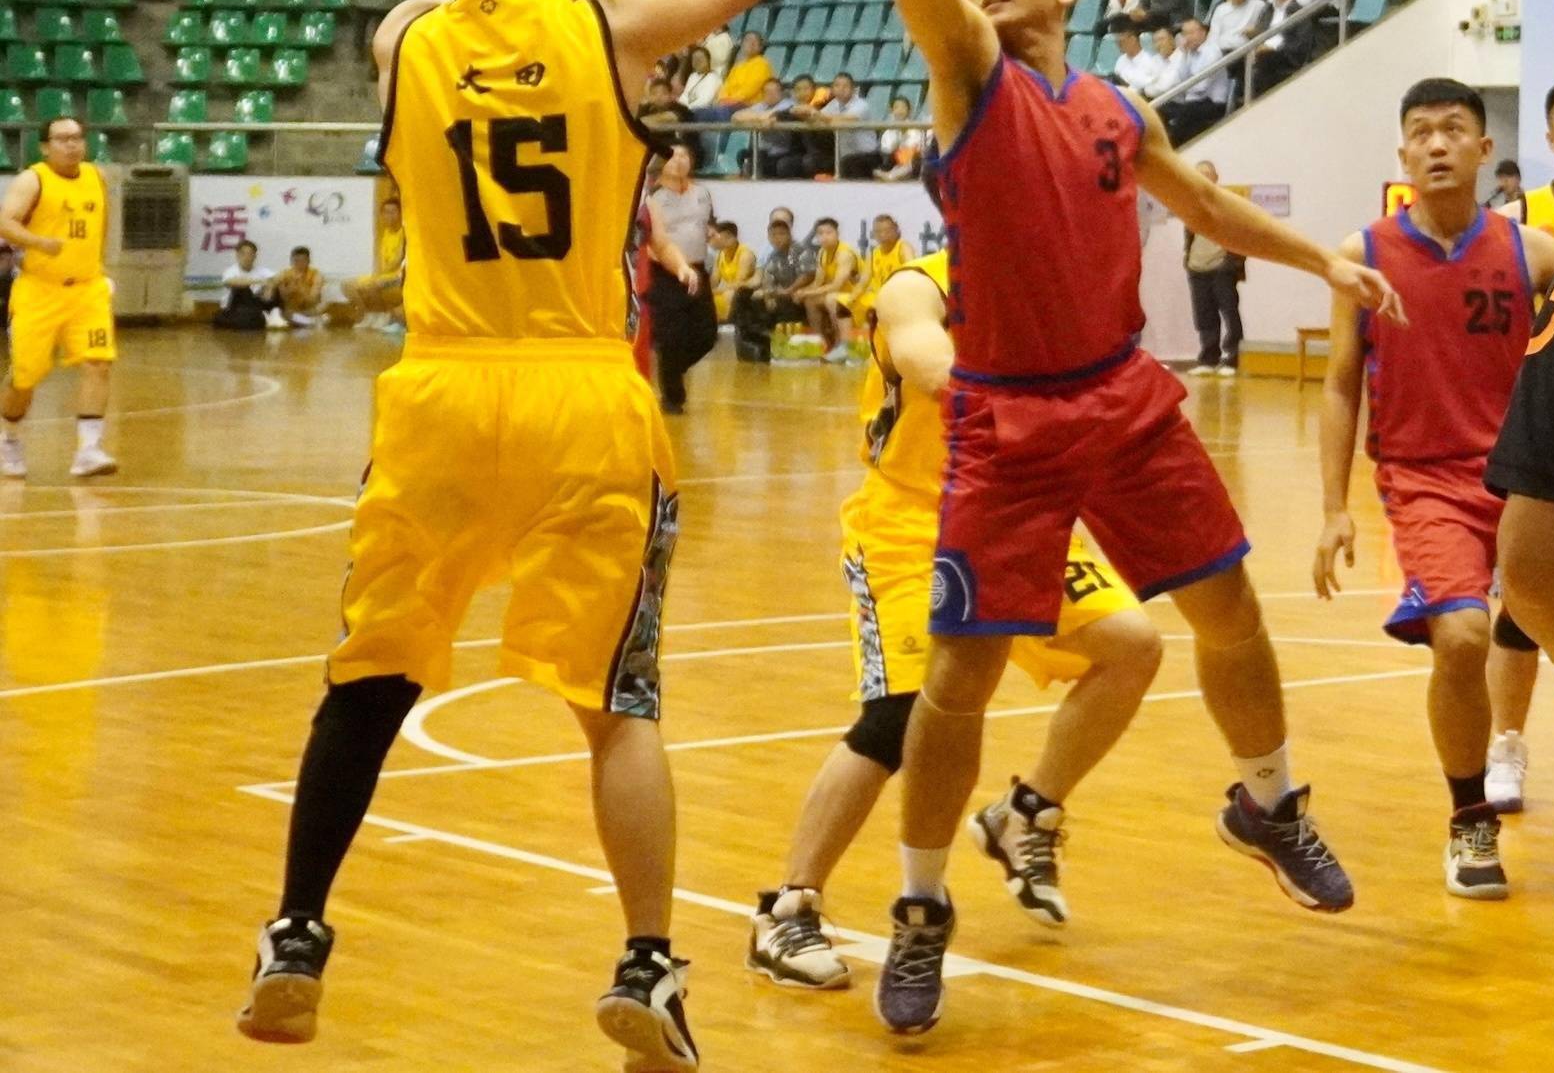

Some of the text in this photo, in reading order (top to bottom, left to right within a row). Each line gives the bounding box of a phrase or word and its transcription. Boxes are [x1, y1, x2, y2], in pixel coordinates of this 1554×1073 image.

[444, 113, 572, 263] 15
[1095, 138, 1121, 193] 3
[69, 219, 87, 239] 18
[1464, 290, 1514, 336] 25
[88, 328, 107, 348] 18
[1065, 560, 1114, 604] 21
